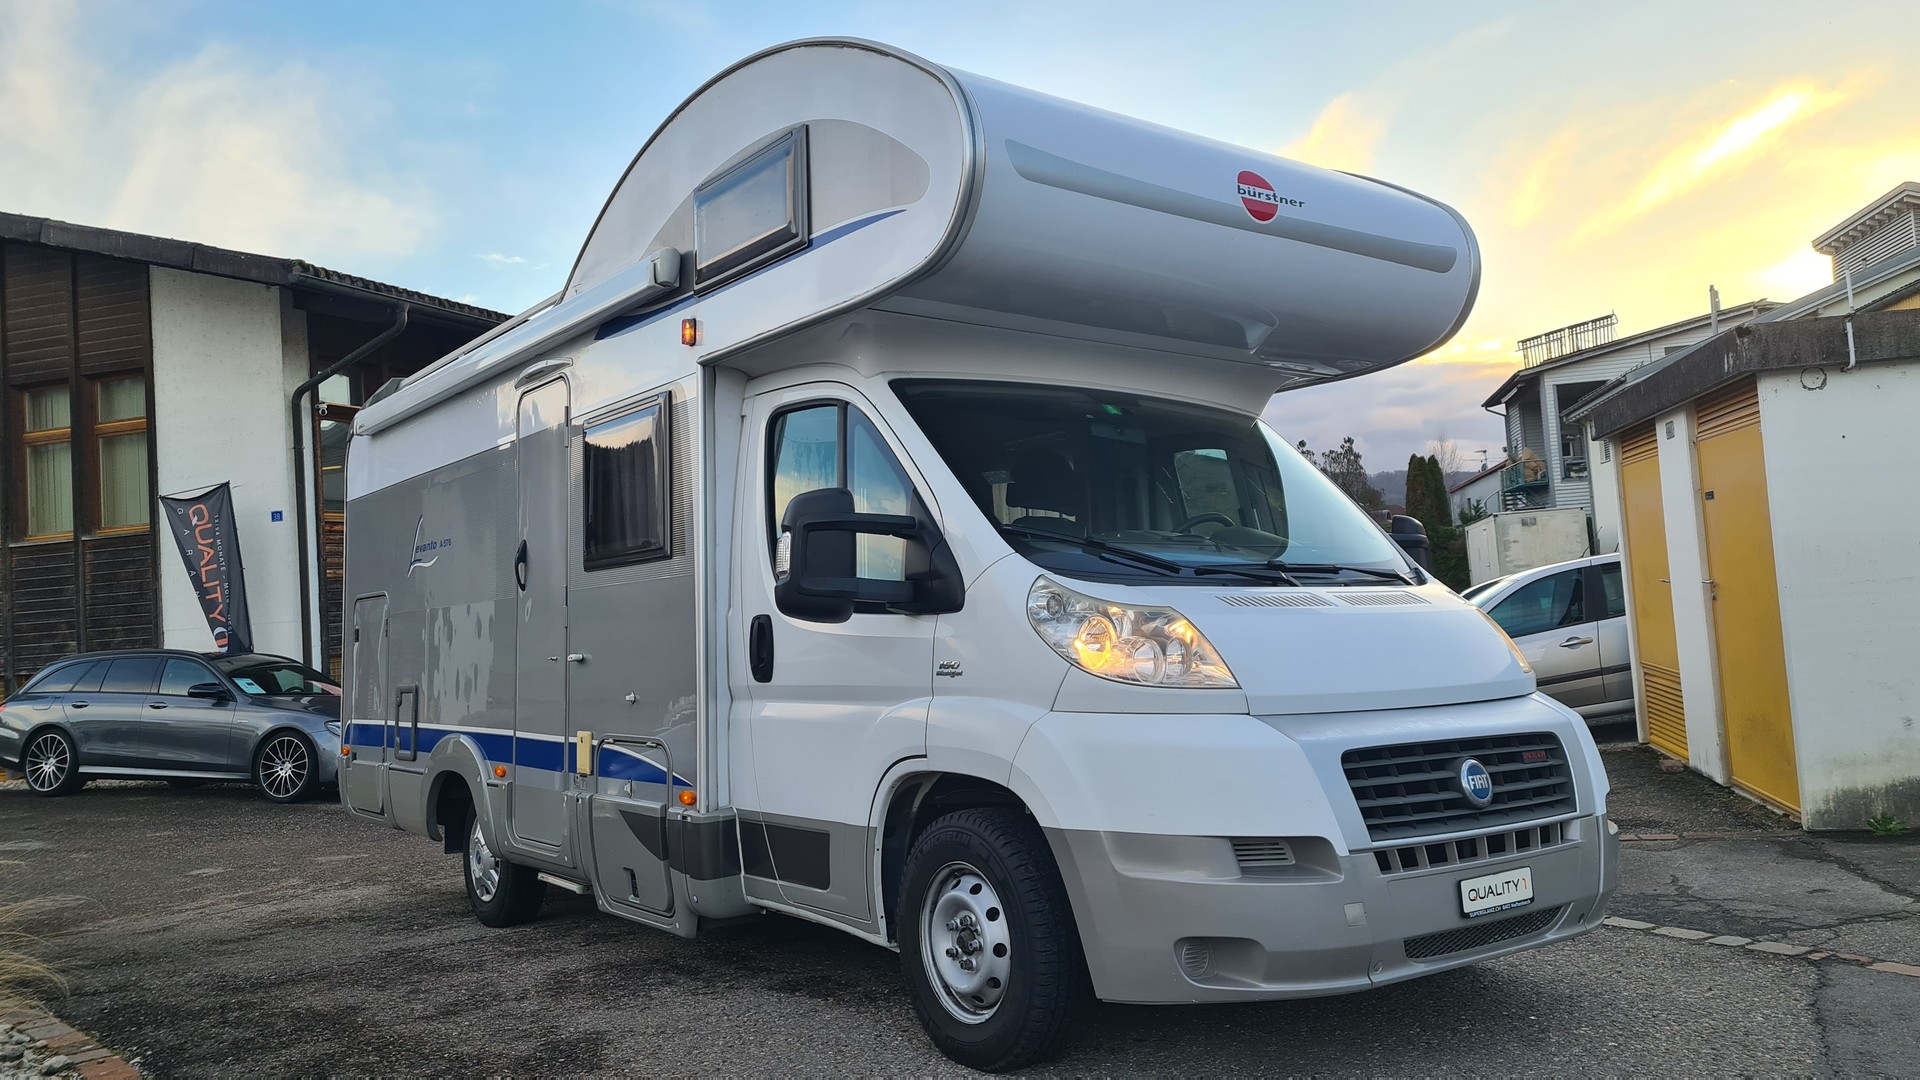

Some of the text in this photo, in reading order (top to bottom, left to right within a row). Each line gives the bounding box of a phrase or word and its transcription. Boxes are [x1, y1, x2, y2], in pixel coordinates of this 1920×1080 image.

[1237, 184, 1306, 208] bürstner
[188, 503, 226, 622] QUALITY
[216, 539, 227, 572] MONATE
[1468, 773, 1489, 791] FIAT
[1468, 878, 1520, 902] QUALITY
